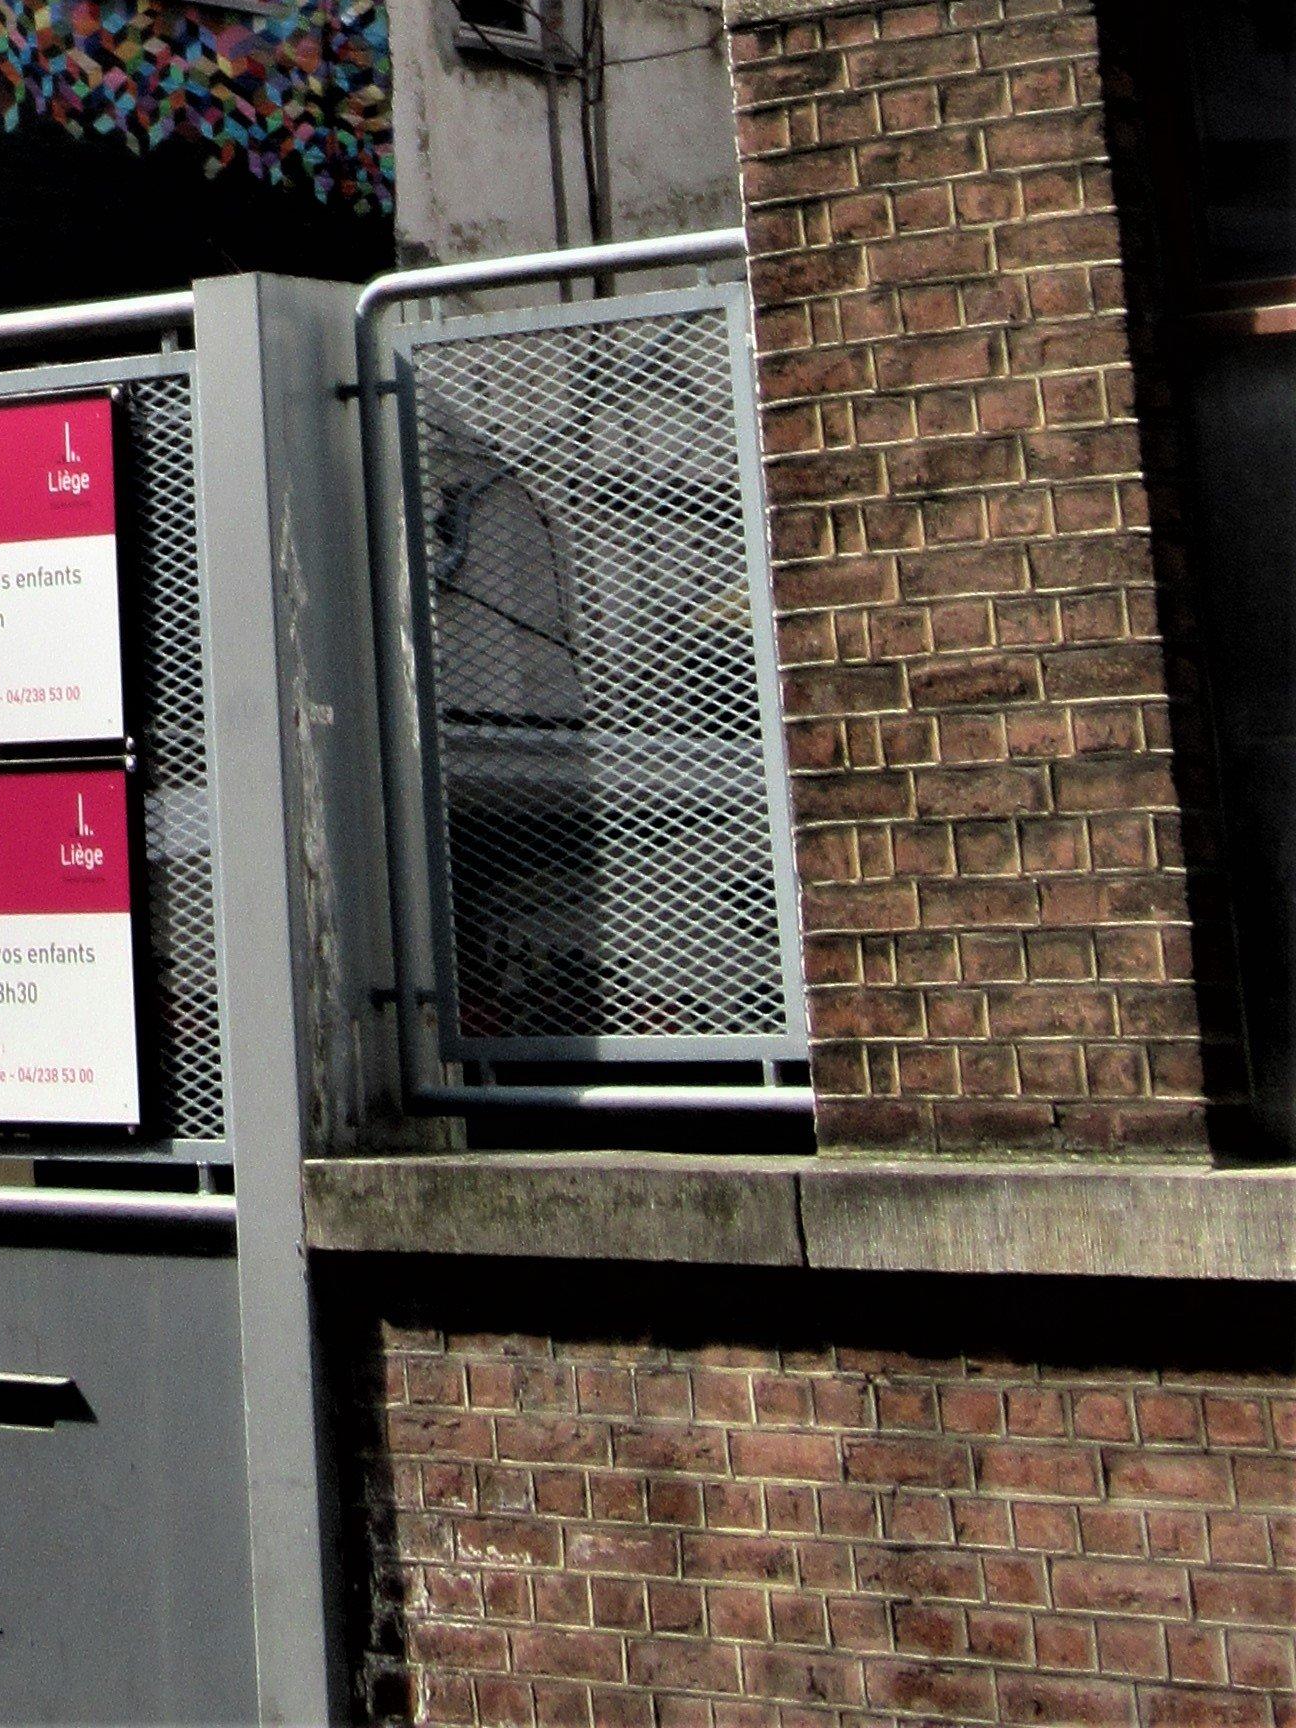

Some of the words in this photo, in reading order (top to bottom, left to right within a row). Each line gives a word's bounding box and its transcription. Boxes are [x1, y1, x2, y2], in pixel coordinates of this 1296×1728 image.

[48, 471, 90, 495] Liège
[16, 566, 82, 588] enfants
[66, 685, 81, 701] 00
[61, 843, 104, 870] Liège
[27, 942, 95, 963] enfants
[61, 1068, 76, 1082] 53
[79, 1068, 94, 1082] 00
